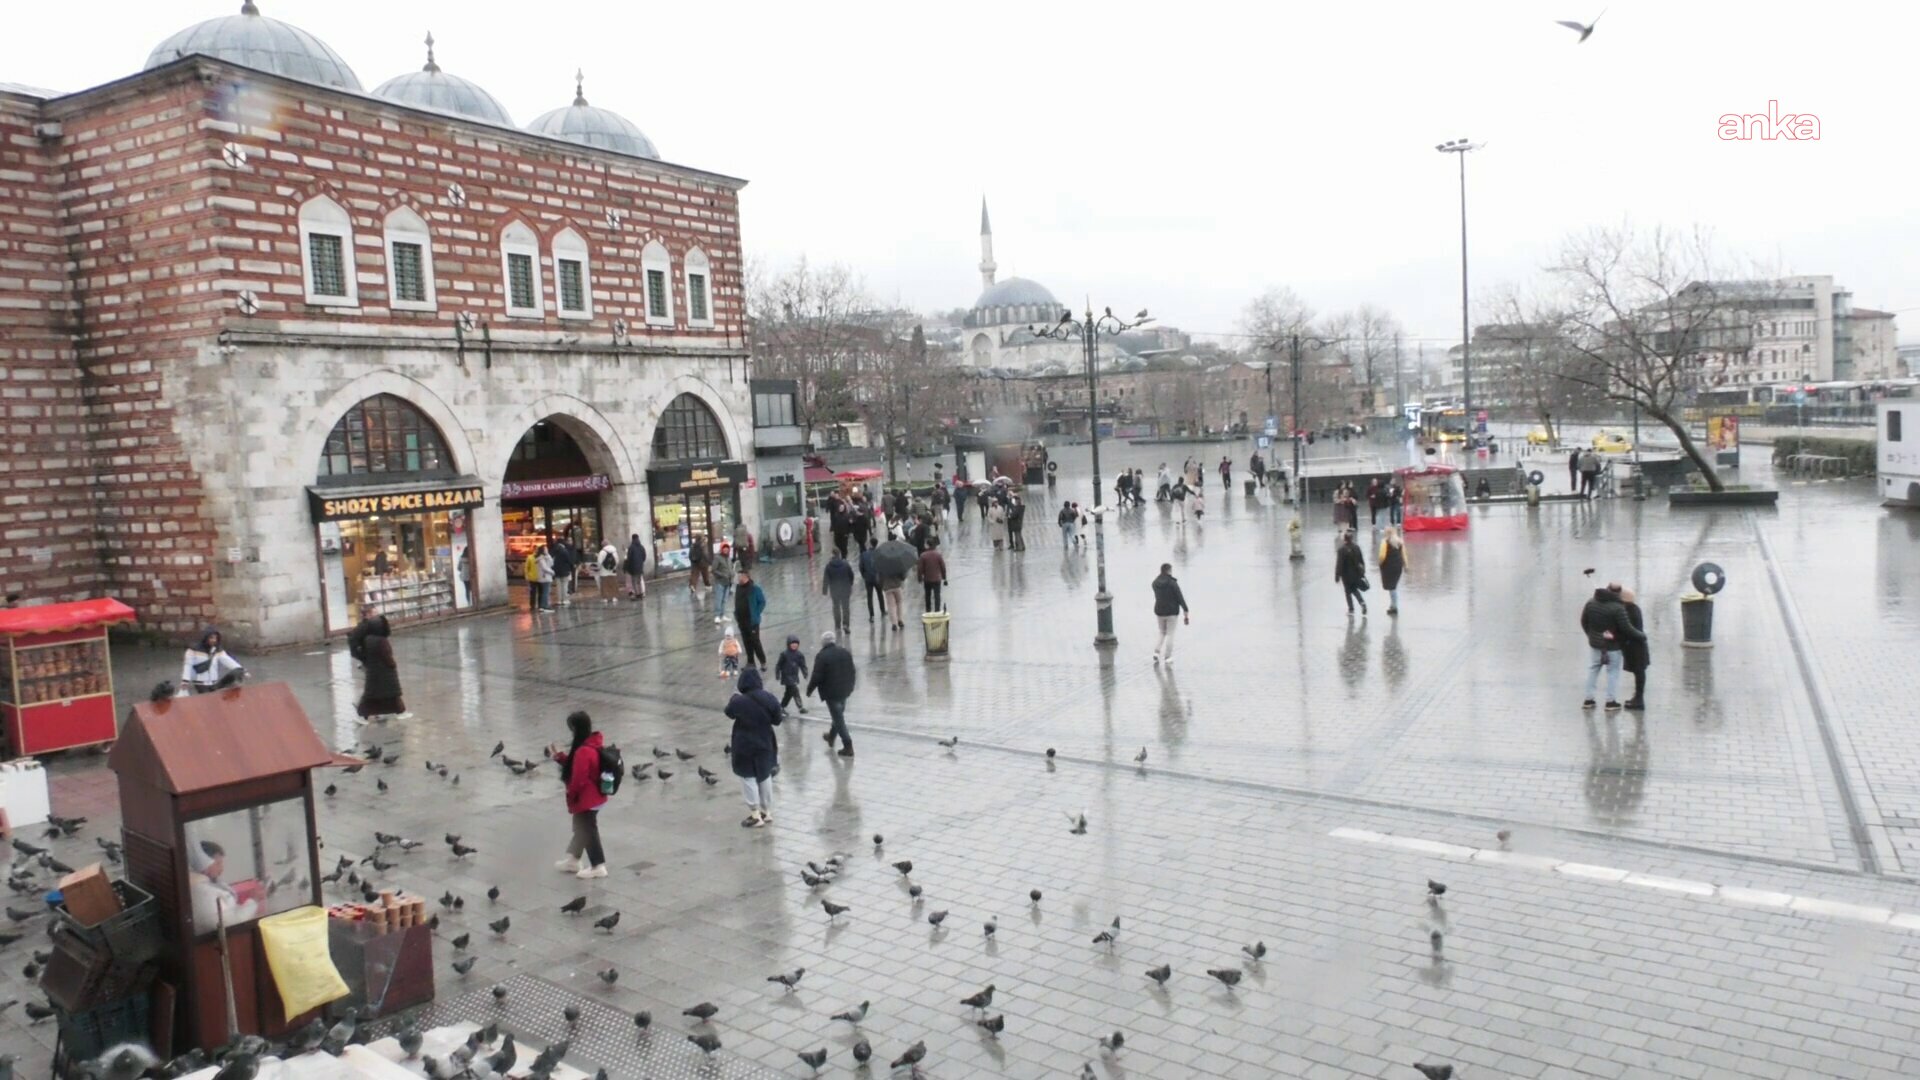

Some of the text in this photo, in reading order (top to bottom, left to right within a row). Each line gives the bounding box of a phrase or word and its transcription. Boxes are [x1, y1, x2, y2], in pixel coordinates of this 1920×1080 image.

[324, 489, 482, 516] SHOZY SPICE BAZAAR
